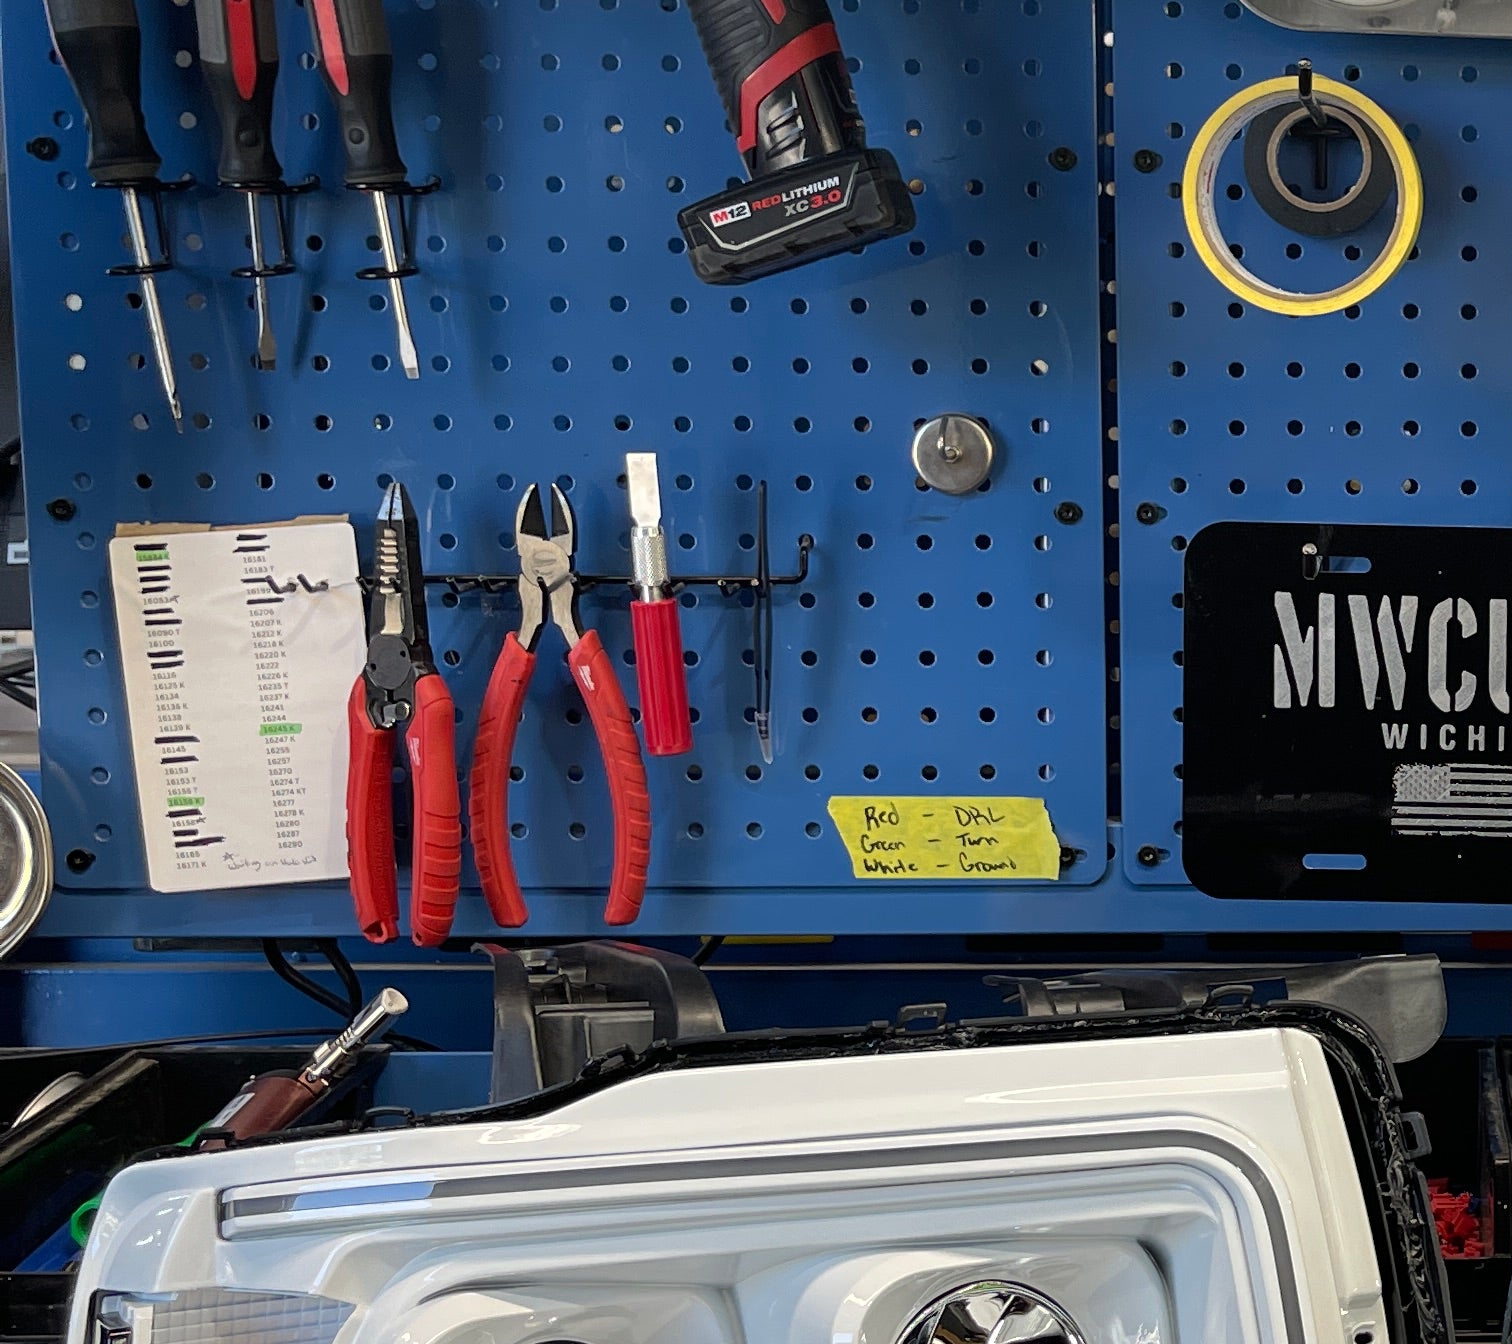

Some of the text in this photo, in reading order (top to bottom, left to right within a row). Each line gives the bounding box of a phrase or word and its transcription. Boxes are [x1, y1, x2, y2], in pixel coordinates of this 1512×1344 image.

[712, 176, 840, 223] M12 REDLITHIUM
[864, 801, 900, 831] Red
[952, 805, 1005, 827] DRL
[860, 834, 906, 854] Green
[955, 832, 1000, 847] Turn
[863, 857, 919, 875] White
[959, 851, 1017, 873] Ground
